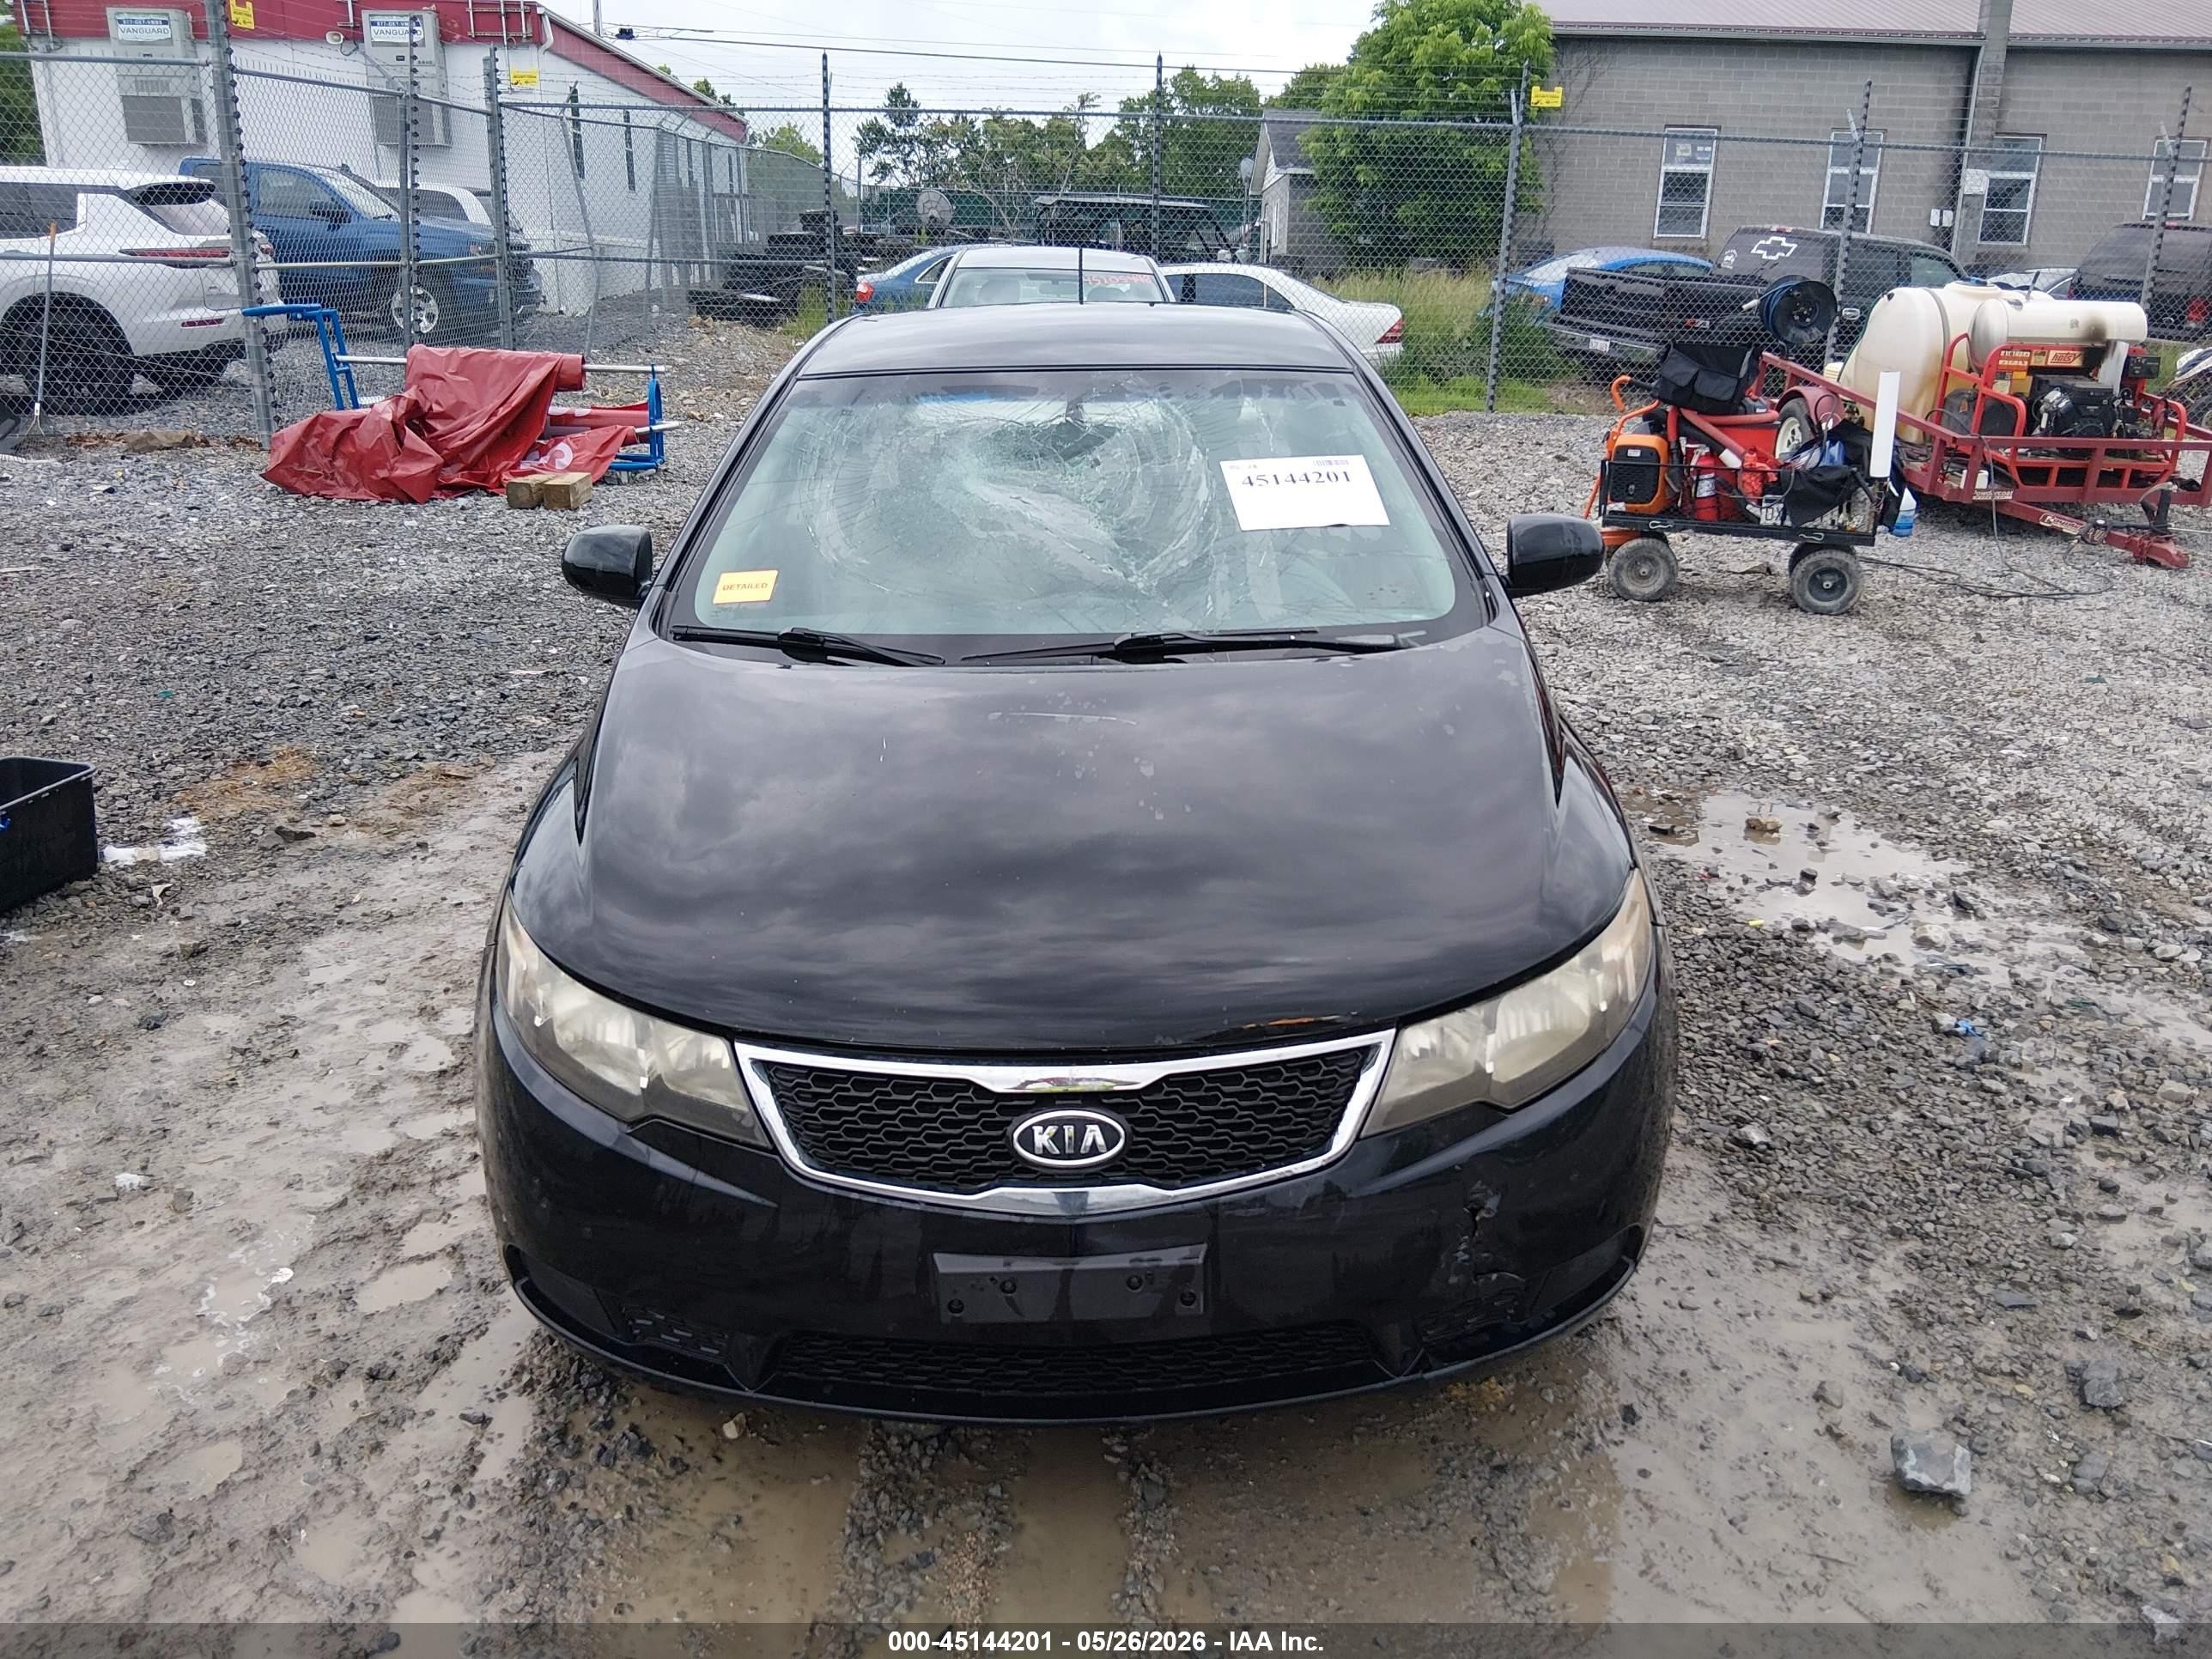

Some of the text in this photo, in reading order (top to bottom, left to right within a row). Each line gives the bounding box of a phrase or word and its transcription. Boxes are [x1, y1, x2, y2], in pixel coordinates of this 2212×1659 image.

[1242, 471, 1352, 487] 45144201
[722, 582, 768, 591] DETAILED
[1031, 1124, 1108, 1155] KIA
